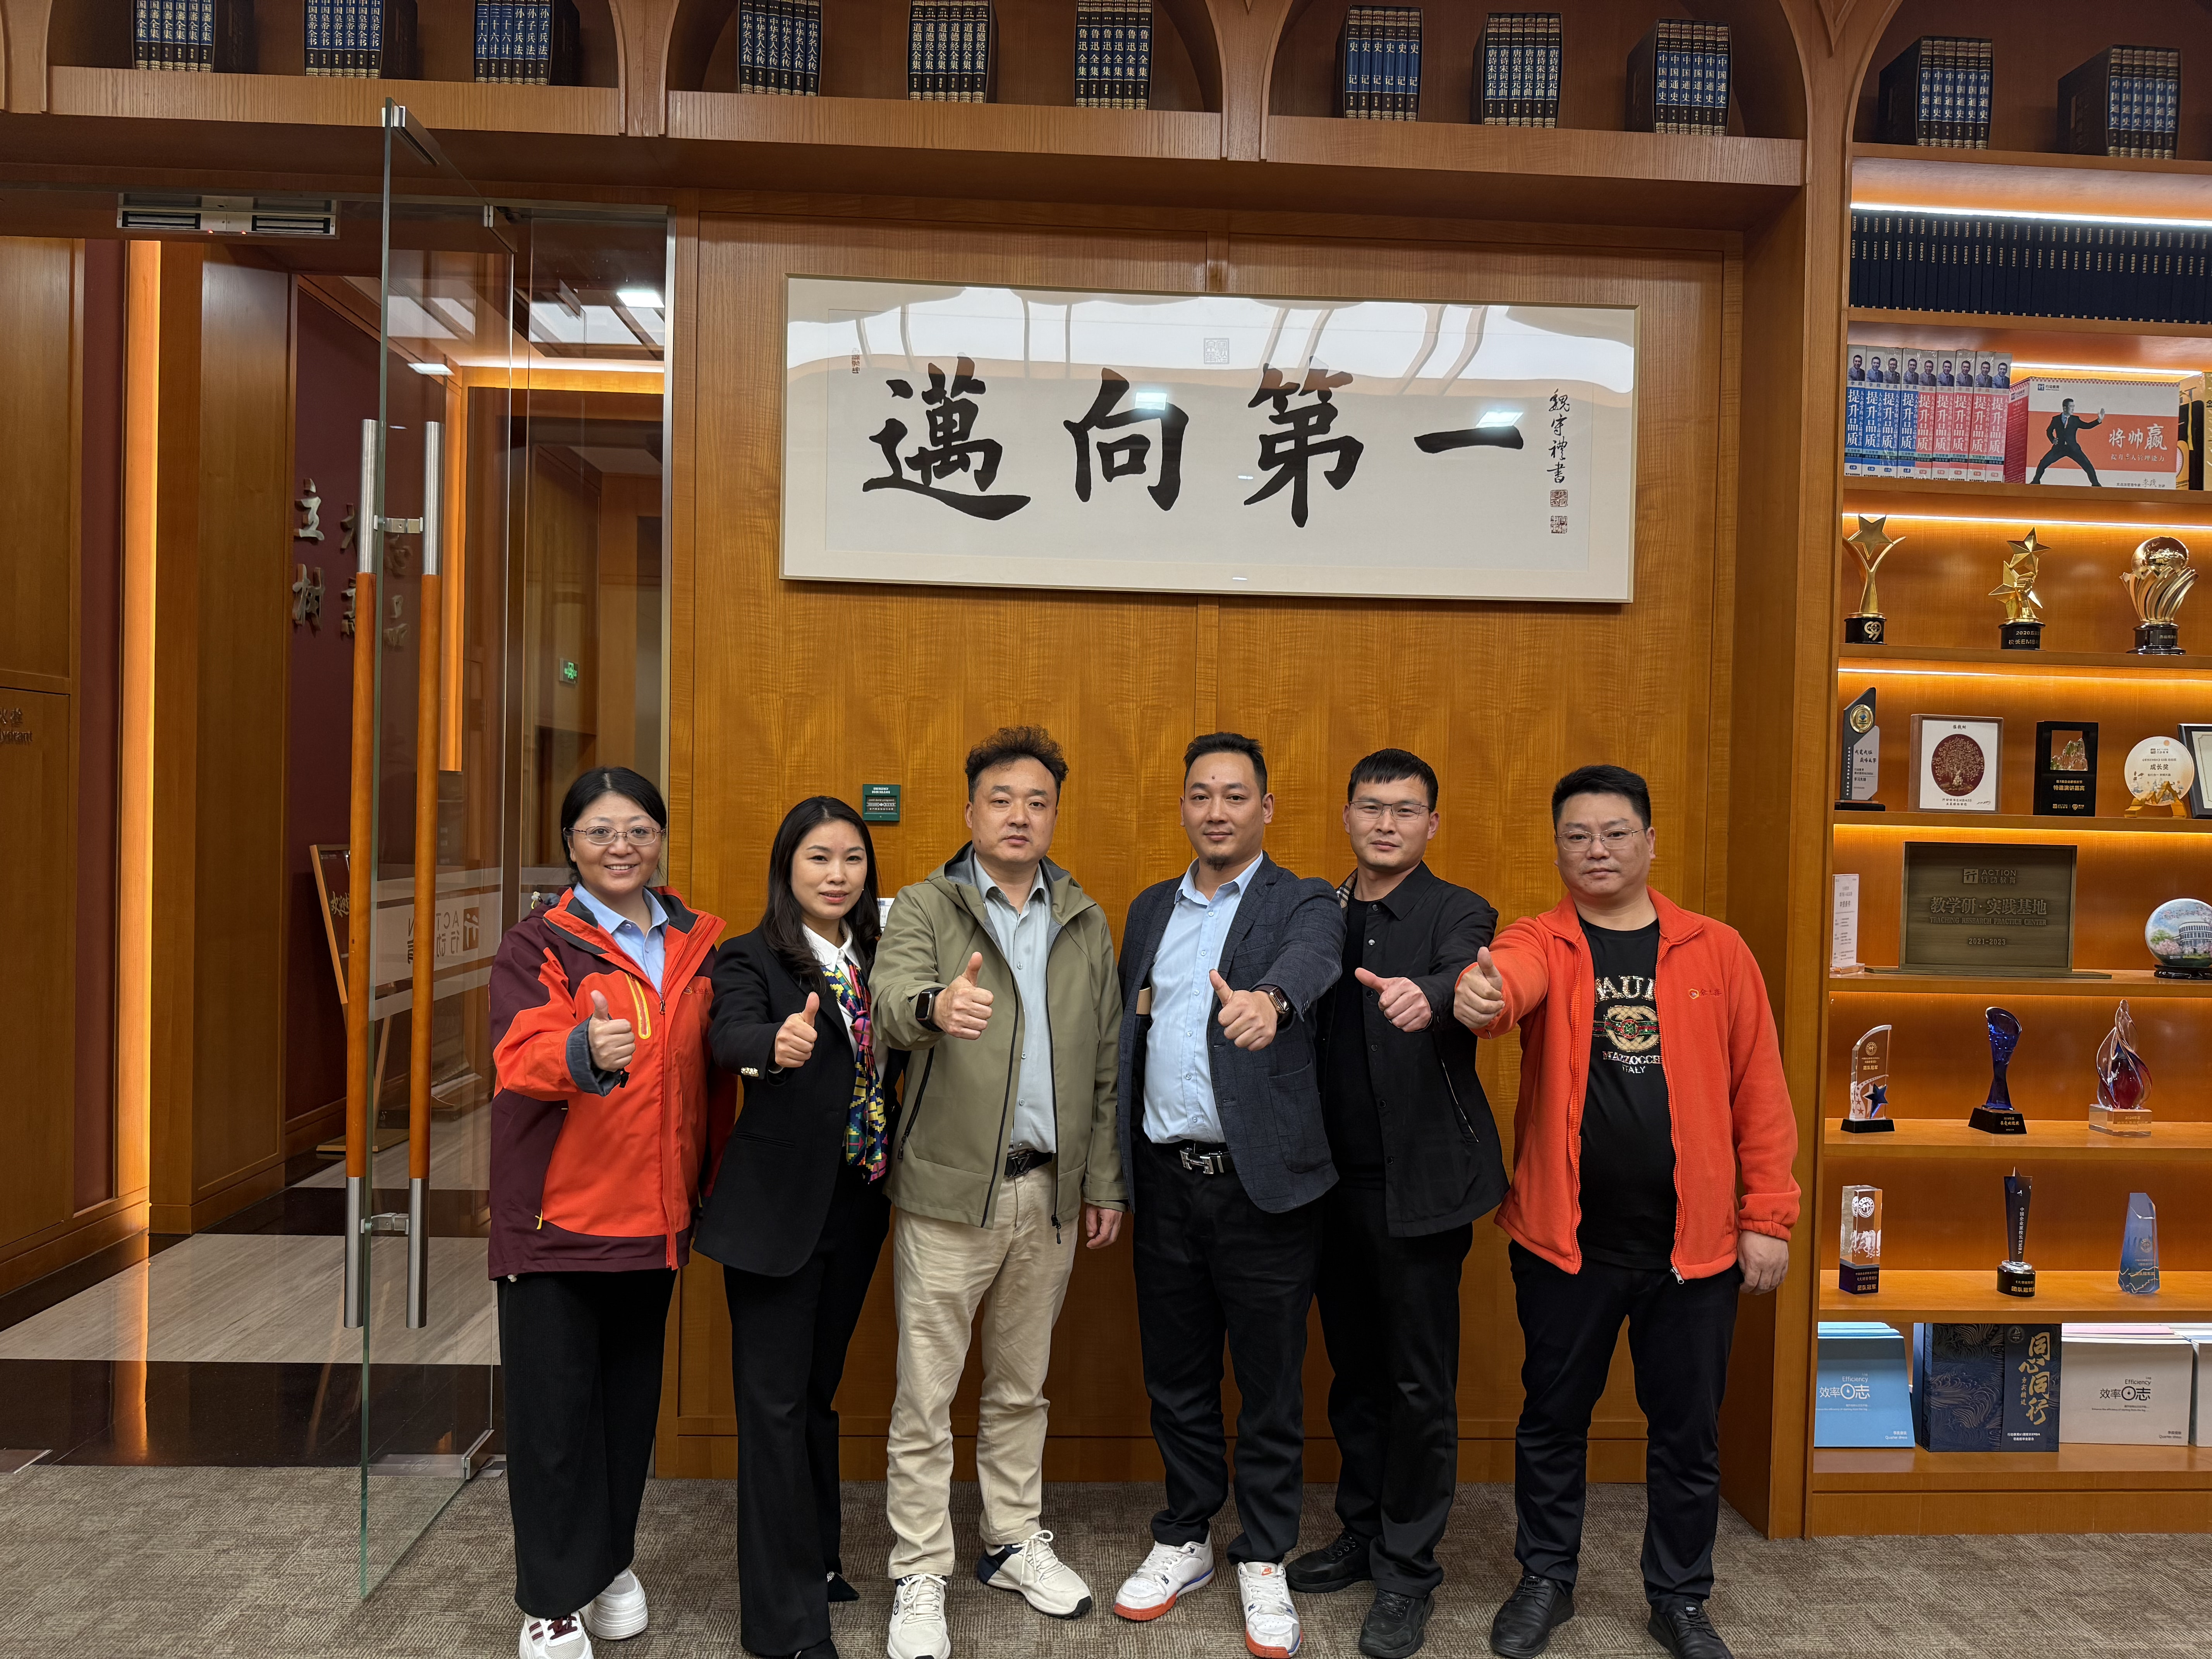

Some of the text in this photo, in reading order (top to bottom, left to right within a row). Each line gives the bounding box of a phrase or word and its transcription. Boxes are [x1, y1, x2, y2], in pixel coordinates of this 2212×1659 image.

[477, 9, 487, 54] 三十六计
[490, 9, 500, 54] 三十六计
[501, 9, 512, 54] 三十六计
[514, 8, 524, 55] 孙子兵法
[526, 8, 536, 55] 孙子兵法
[539, 9, 549, 55] 孙子兵法
[743, 15, 752, 62] 中华名人大传
[756, 16, 765, 64] 中华名人大传
[769, 18, 778, 65] 中华名人大传
[782, 19, 791, 67] 中华名人大传
[795, 21, 804, 69] 中华名人大传
[808, 23, 817, 70] 中华名人大传
[912, 23, 922, 70] 道德经全集
[925, 23, 934, 69] 道德经全集
[938, 23, 947, 70] 道德经全集
[950, 23, 960, 70] 道德经全集
[963, 23, 973, 69] 道德经全集
[975, 23, 986, 70] 道德经全集
[1349, 42, 1358, 84] 史记
[1361, 42, 1370, 84] 史记
[1373, 42, 1382, 84] 史记
[1385, 43, 1395, 85] 史记
[1398, 43, 1407, 86] 史记
[1410, 44, 1419, 86] 史记
[1487, 49, 1497, 96] 唐诗宋词元曲
[1499, 49, 1509, 96] 唐诗宋词元曲
[1511, 49, 1522, 96] 唐诗宋词元曲
[1524, 49, 1534, 96] 唐诗宋词元曲
[1536, 49, 1546, 96] 唐诗宋词元曲
[1548, 50, 1559, 97] 唐诗宋词元曲
[1658, 54, 1667, 101] 中国通史
[1670, 55, 1679, 101] 中国通史
[1682, 55, 1690, 101] 中国通史
[1693, 56, 1702, 102] 中国通史
[1705, 57, 1714, 103] 中国通史
[1717, 58, 1726, 104] 中国通史
[1921, 71, 1930, 117] 中国通史
[1933, 71, 1943, 117] 中国通史
[1944, 72, 1954, 117] 中国通史
[1956, 72, 1966, 118] 中国通史
[1968, 73, 1977, 118] 中国通史
[1979, 74, 1990, 119] 中国通史
[1846, 389, 1860, 446] 提升品质
[1865, 391, 1878, 448] 提升品质
[1882, 392, 1895, 448] 提升品质
[1900, 393, 1914, 449] 提升品质
[1917, 395, 1930, 451] 提升品质
[1935, 395, 1949, 451] 提升品质
[1952, 395, 1966, 451] 提升品质
[1972, 396, 1986, 452] 提升品质
[1989, 397, 2003, 453] 提升品质
[2109, 423, 2167, 450] 将帅赢
[1982, 876, 2016, 884] 行动教育
[331, 891, 350, 918] 欢迎
[1930, 896, 2047, 915] 教学研·实践基地
[1622, 1065, 1645, 1073] ITALY
[2018, 1332, 2050, 1425] 同心同行
